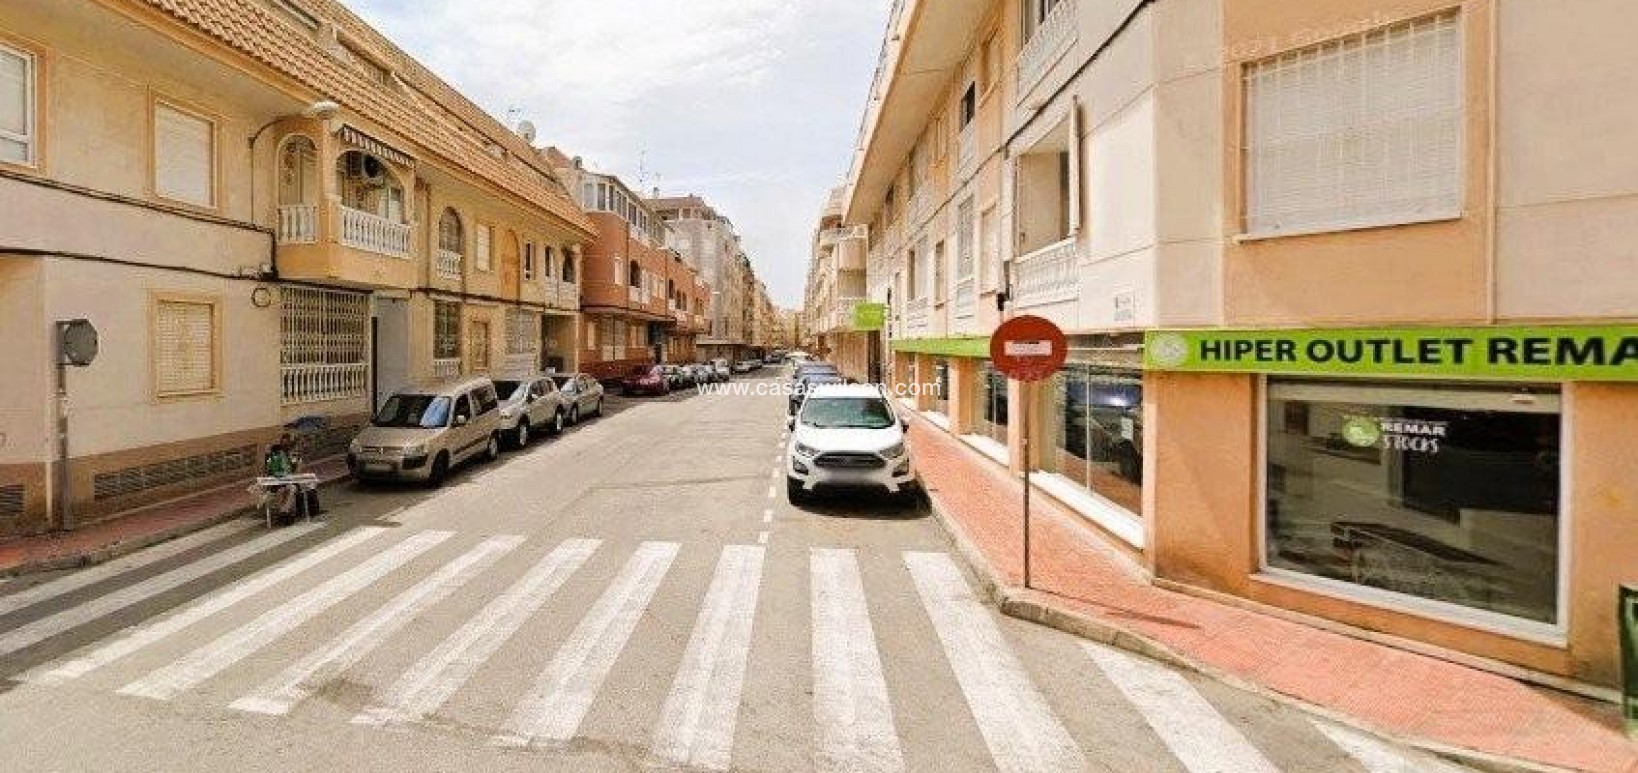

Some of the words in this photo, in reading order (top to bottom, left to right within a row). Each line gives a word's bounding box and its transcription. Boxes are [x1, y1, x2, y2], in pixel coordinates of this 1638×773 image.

[1201, 339, 1297, 361] HIPER
[1306, 339, 1474, 364] OUTLET
[1381, 422, 1446, 436] REMAR
